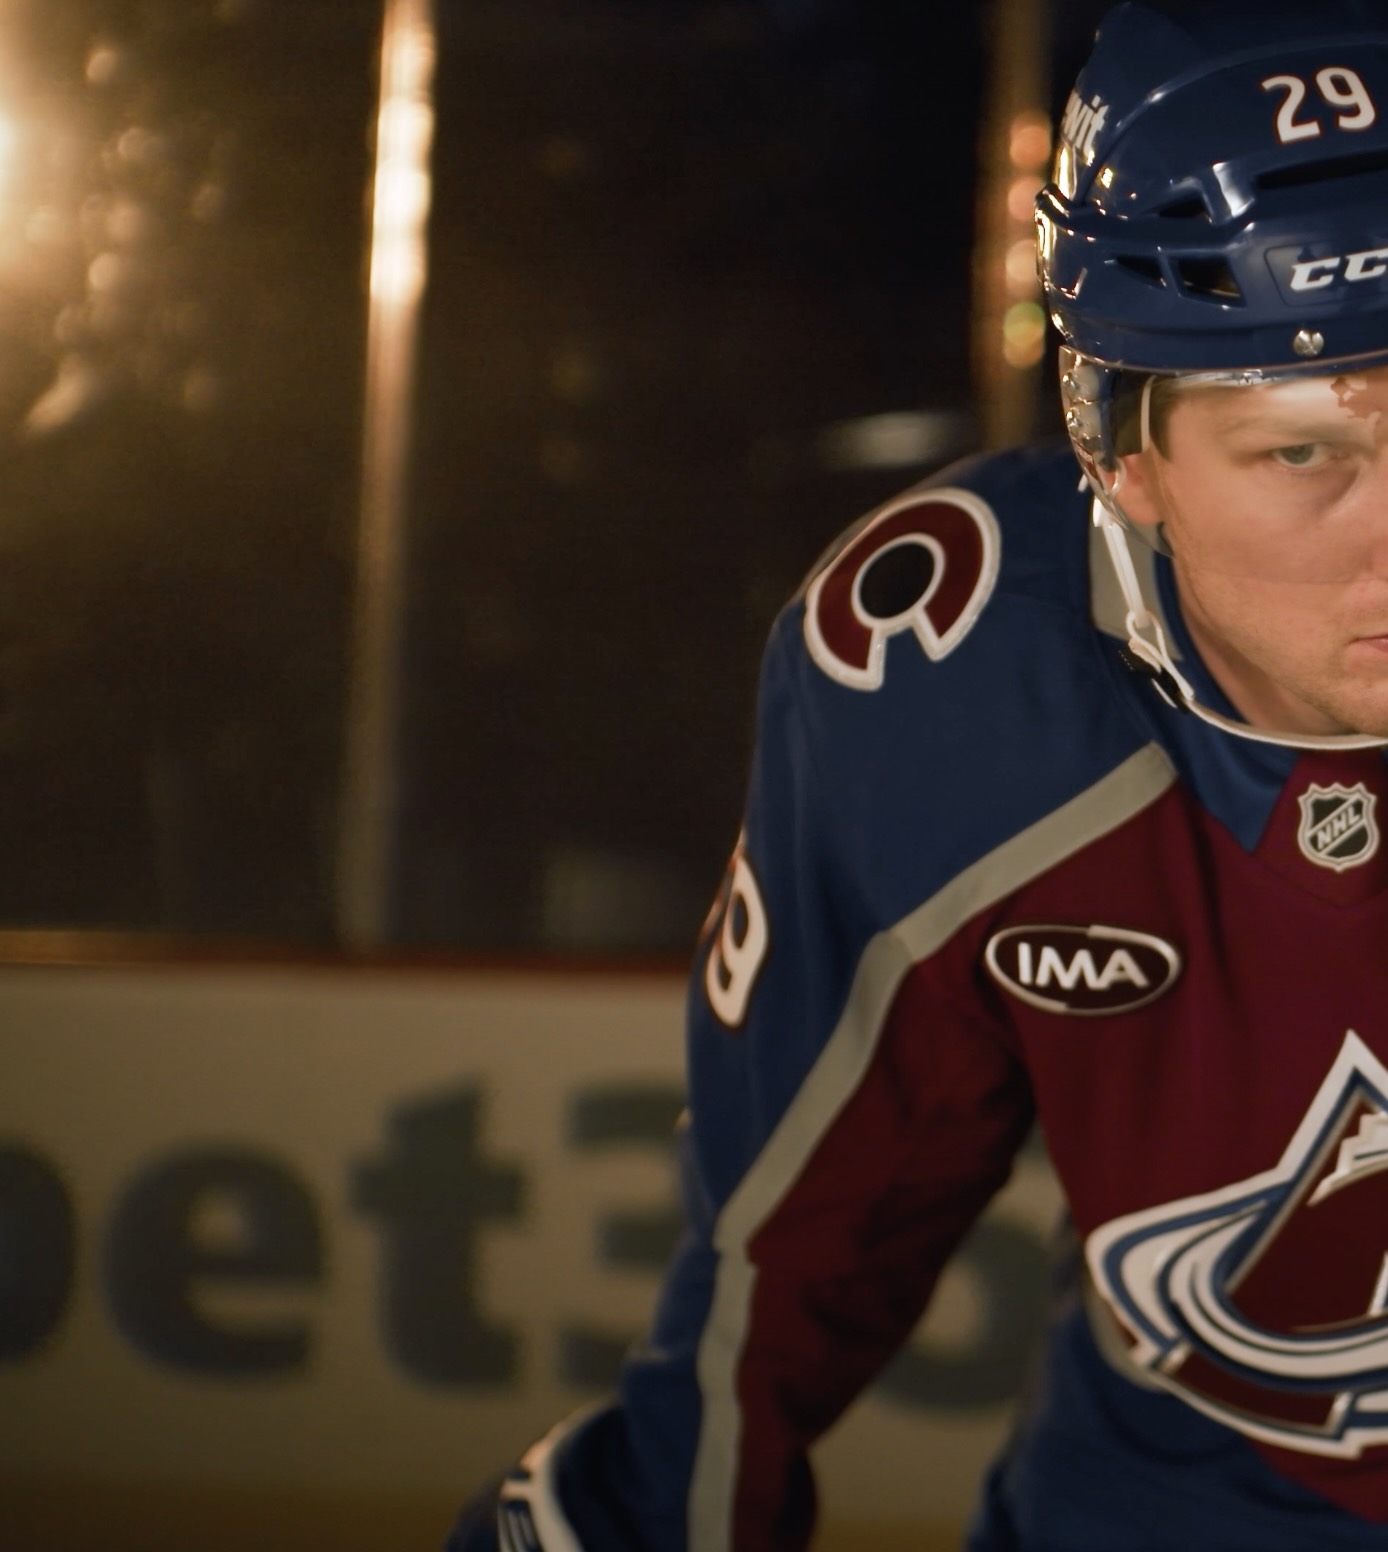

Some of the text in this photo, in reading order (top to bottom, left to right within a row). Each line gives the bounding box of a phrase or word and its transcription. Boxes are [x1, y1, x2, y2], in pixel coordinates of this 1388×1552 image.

[1262, 66, 1377, 143] 29
[1315, 804, 1364, 850] NHL
[700, 828, 769, 1028] 9
[1017, 941, 1150, 990] IMA
